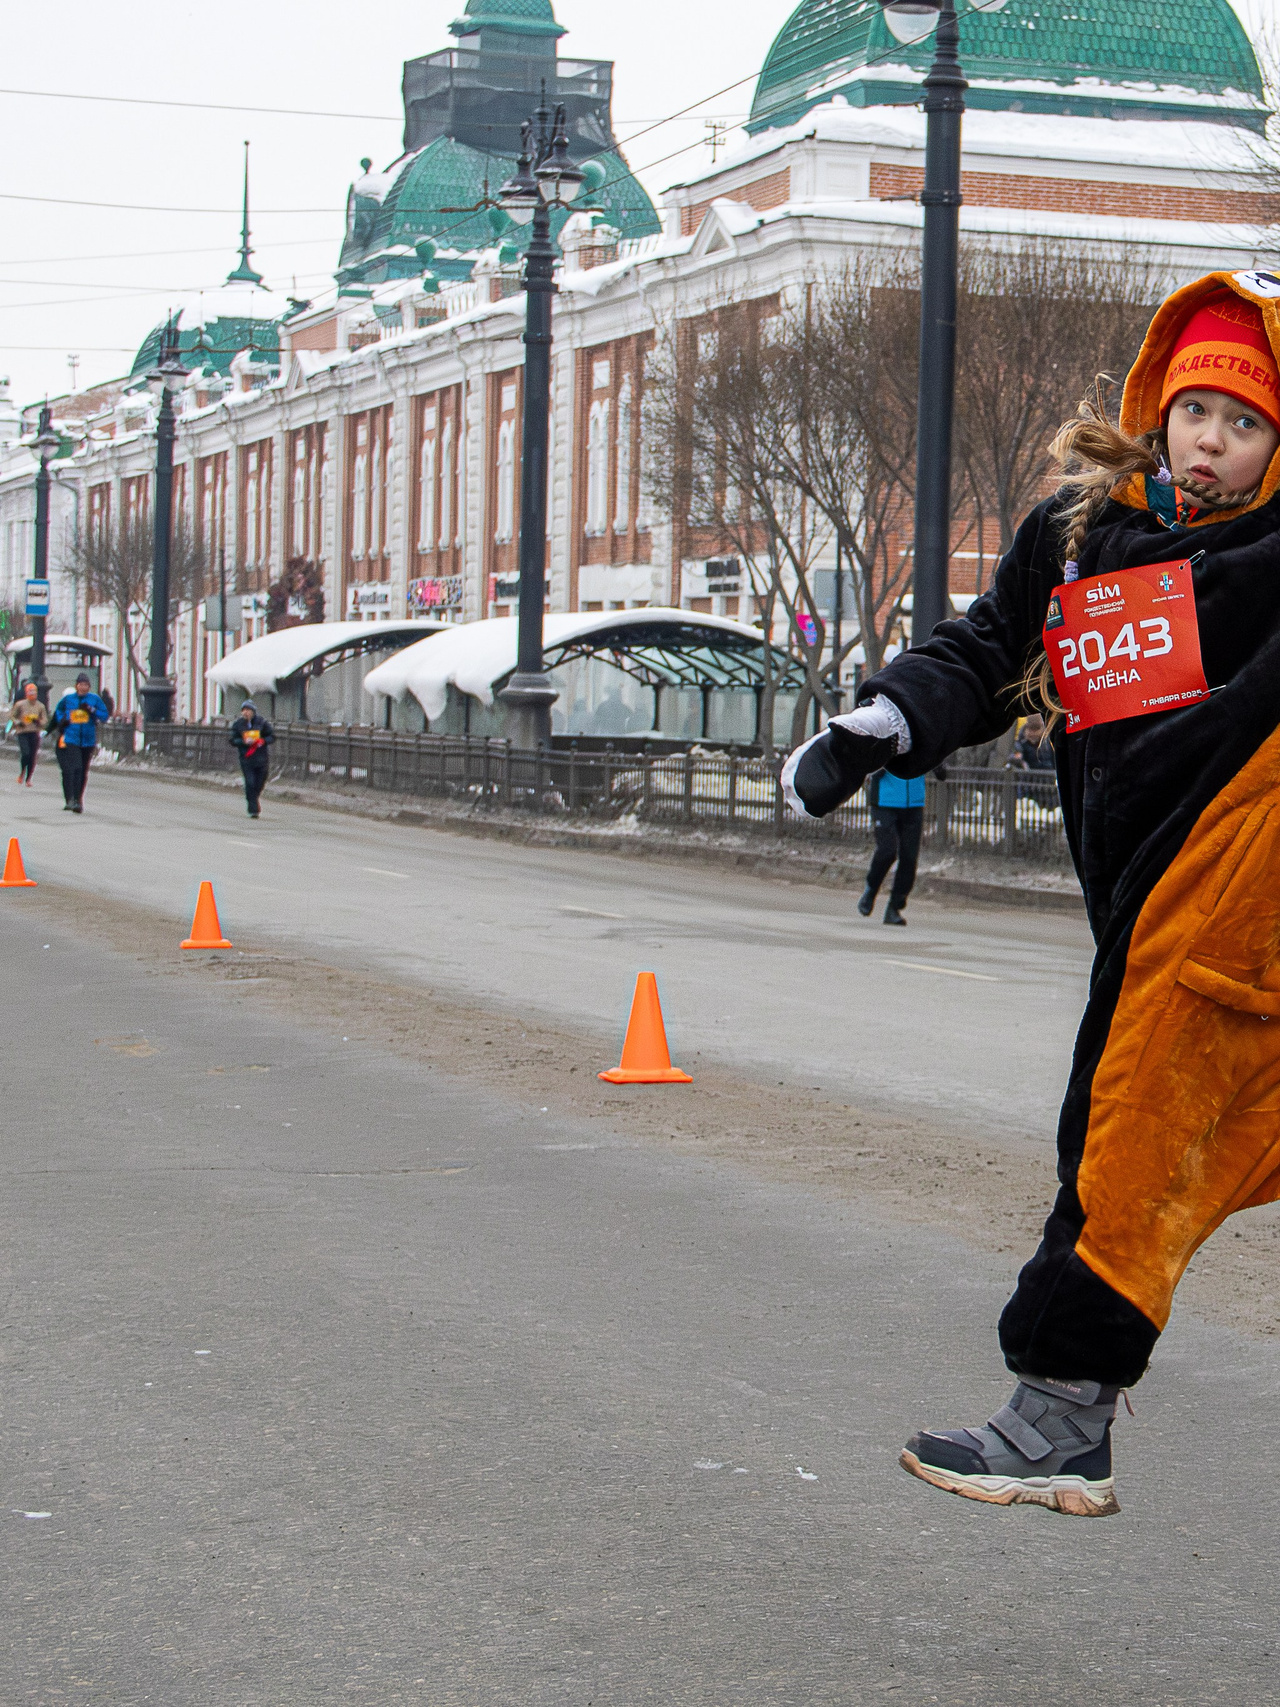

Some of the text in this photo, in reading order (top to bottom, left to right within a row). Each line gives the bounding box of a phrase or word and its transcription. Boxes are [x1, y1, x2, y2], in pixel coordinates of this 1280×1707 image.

[1058, 616, 1173, 678] 2043
[1087, 668, 1142, 693] АЛЁНА
[1141, 700, 1148, 708] 7
[1149, 693, 1180, 706] ЯНВАРЯ
